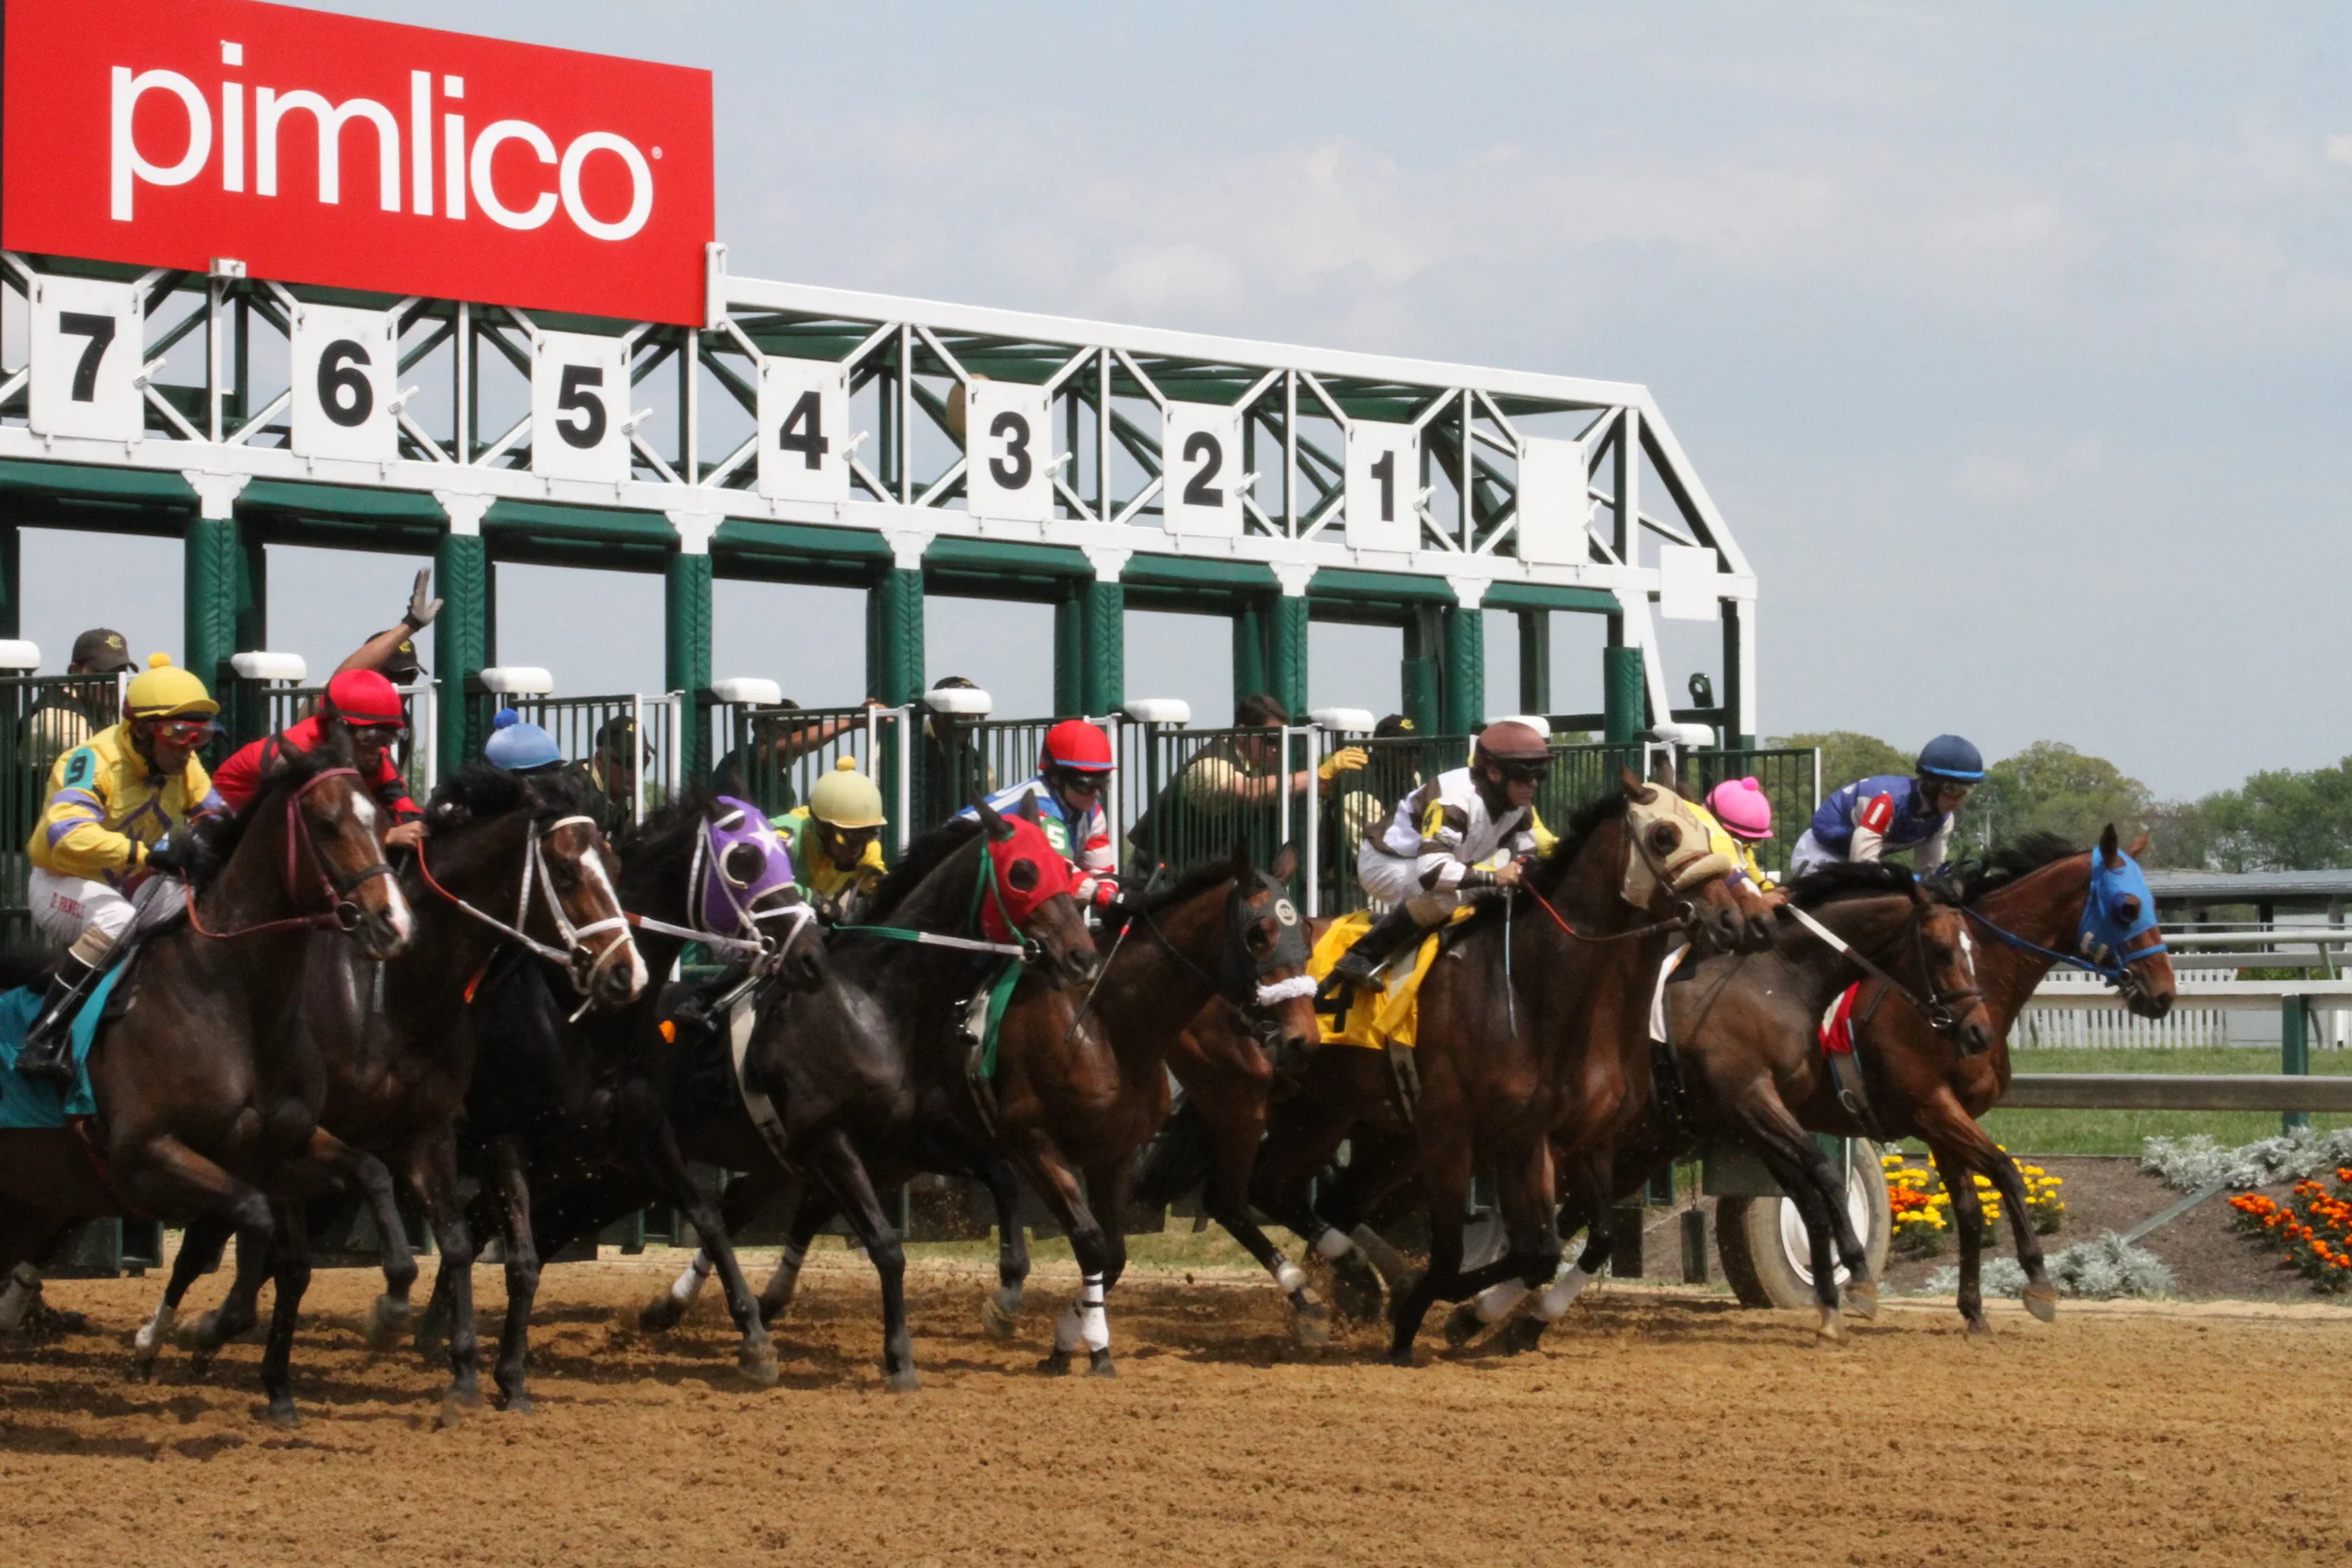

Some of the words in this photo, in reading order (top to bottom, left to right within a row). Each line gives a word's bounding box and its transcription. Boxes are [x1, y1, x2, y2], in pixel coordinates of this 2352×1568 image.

[112, 42, 653, 241] pimlico
[60, 312, 115, 403] 7
[318, 340, 373, 427] 6
[556, 365, 606, 449] 5
[780, 391, 828, 469] 4
[990, 411, 1031, 489] 3
[1184, 432, 1222, 507] 2
[1371, 451, 1393, 521] 1
[68, 755, 87, 786] 9
[1047, 824, 1065, 849] 5
[1423, 809, 1435, 832] 4
